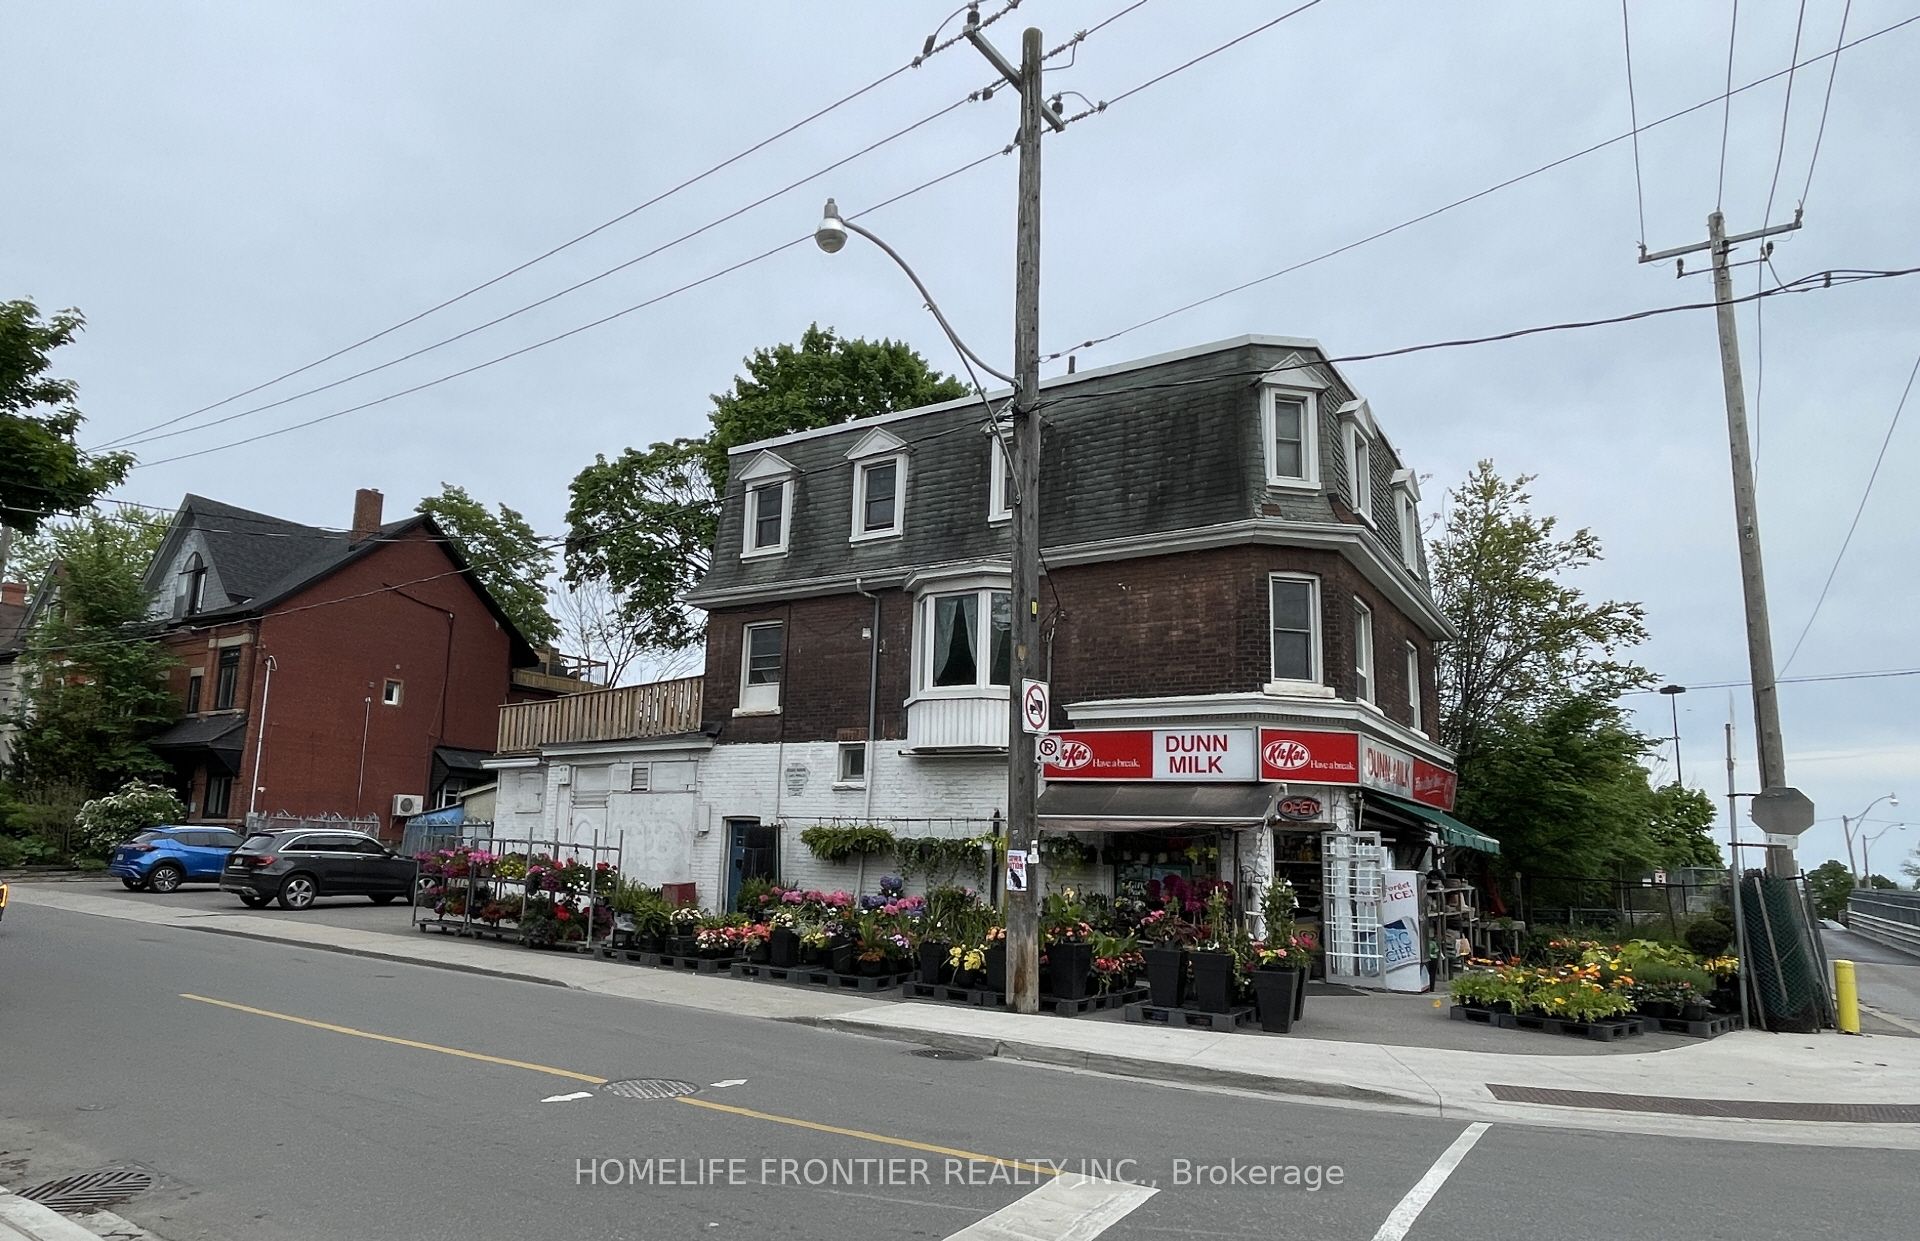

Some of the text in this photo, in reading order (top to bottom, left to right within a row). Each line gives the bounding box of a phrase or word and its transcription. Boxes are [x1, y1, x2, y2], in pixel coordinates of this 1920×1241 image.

[1166, 734, 1228, 752] DUNN
[1268, 743, 1305, 766] KitKat
[1092, 758, 1111, 768] Have
[1169, 755, 1224, 773] MILK
[1310, 759, 1328, 769] Have
[1367, 747, 1391, 782] DUNN
[1281, 801, 1322, 814] OPEN
[1389, 889, 1415, 901] ICE!
